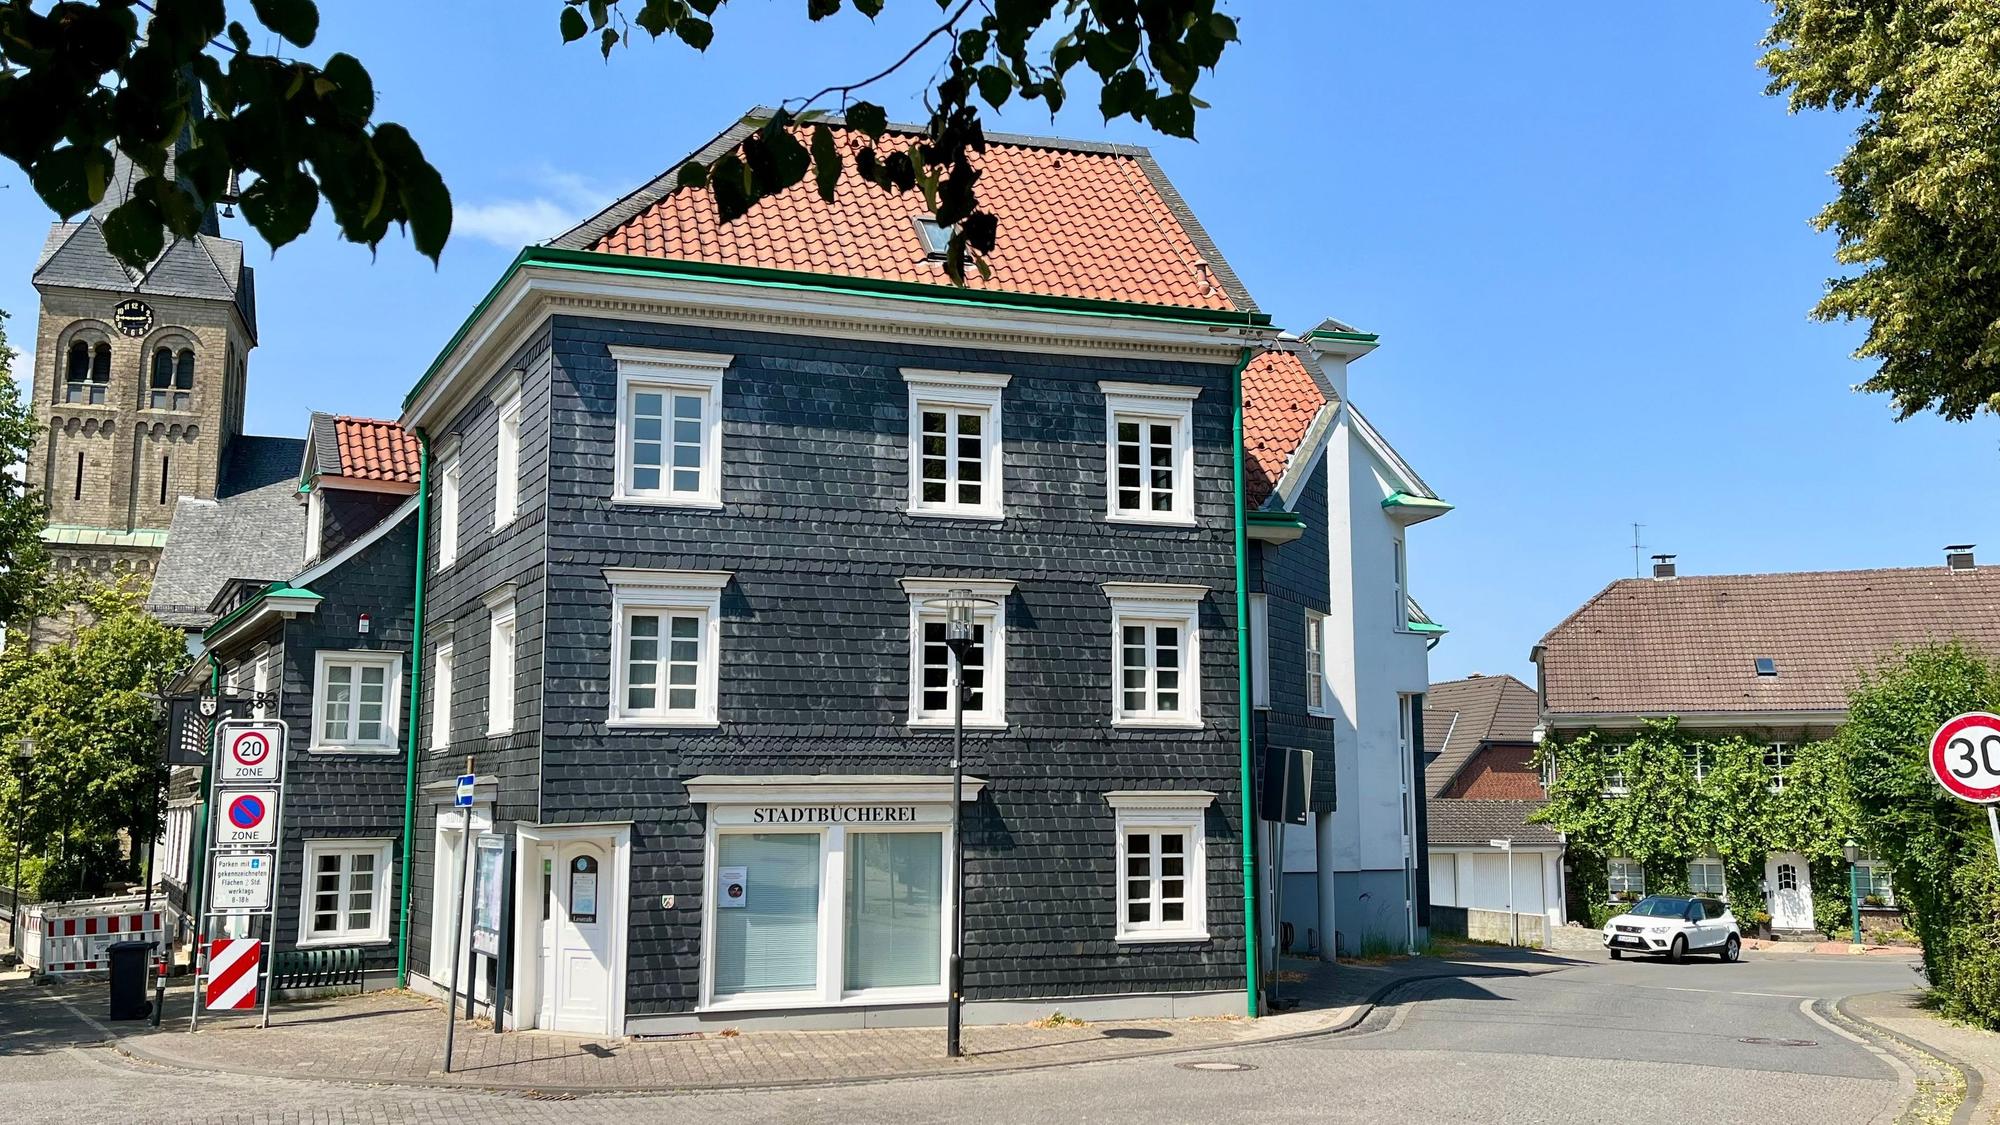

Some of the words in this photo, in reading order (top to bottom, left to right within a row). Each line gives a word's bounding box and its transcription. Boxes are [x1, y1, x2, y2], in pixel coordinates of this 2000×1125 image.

[240, 741, 262, 757] 20
[1948, 734, 2000, 779] 30
[235, 767, 263, 777] ZONE
[753, 805, 917, 823] STADTBÜCHEREI
[231, 831, 259, 840] ZONE
[218, 860, 239, 868] Parken
[240, 860, 250, 868] mit
[217, 870, 268, 879] gekennzeichneten
[228, 887, 254, 896] werktags
